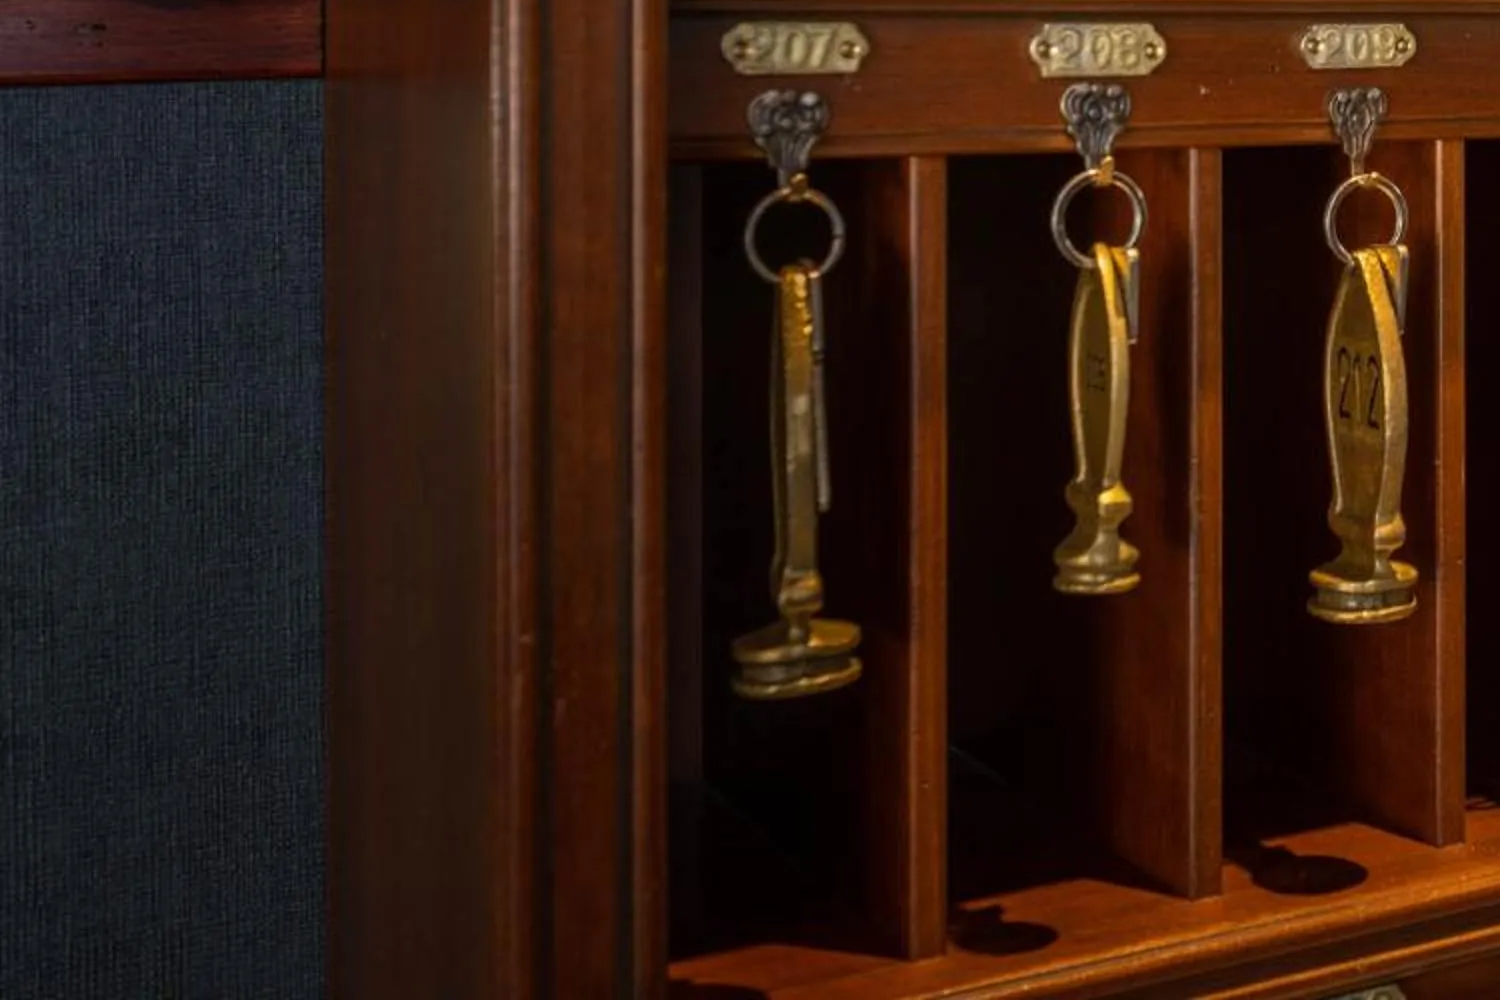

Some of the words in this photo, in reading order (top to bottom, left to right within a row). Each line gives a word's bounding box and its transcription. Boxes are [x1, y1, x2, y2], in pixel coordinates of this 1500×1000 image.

[752, 25, 834, 70] 207
[1055, 27, 1141, 70] 208
[1323, 25, 1395, 64] 209
[1337, 346, 1380, 430] 212
